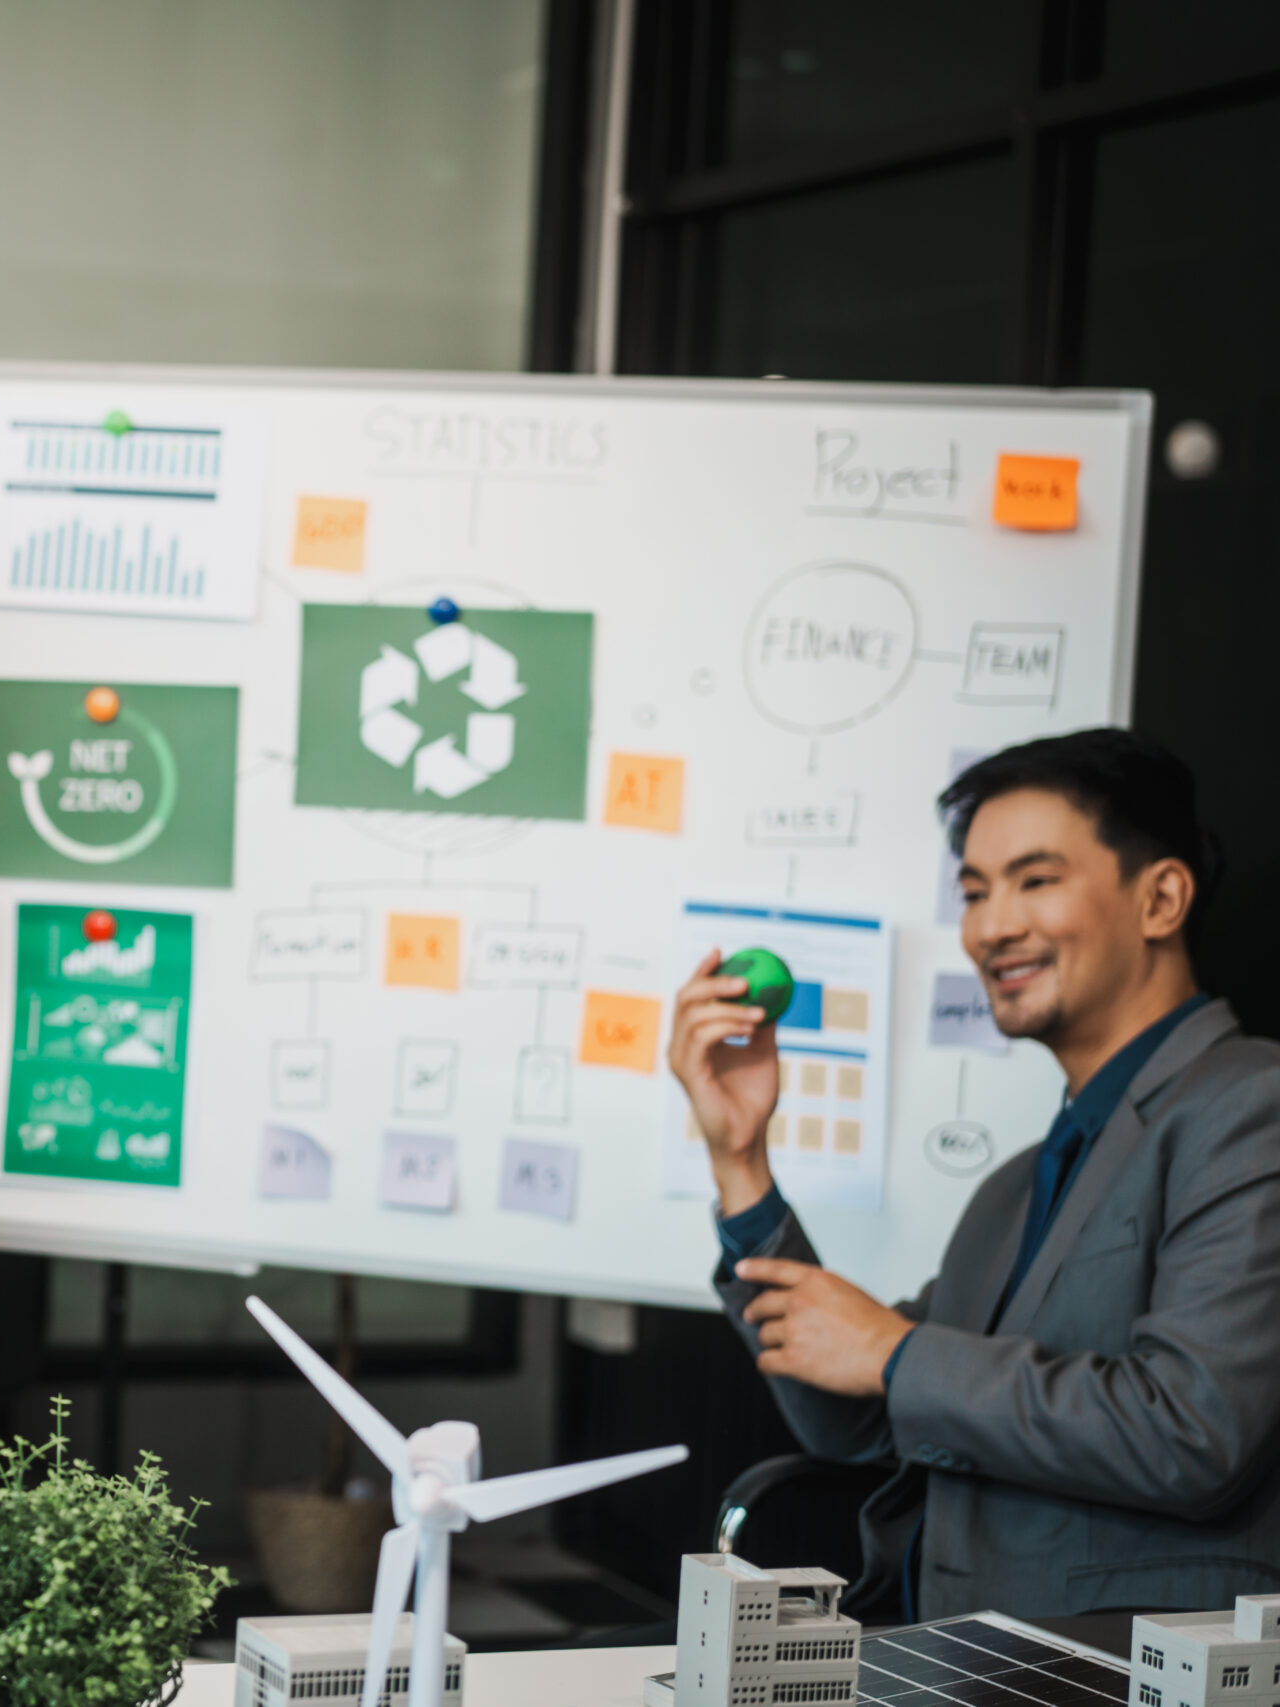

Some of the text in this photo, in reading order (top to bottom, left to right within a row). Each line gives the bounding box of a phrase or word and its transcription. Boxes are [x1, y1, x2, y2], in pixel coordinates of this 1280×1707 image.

[362, 405, 611, 468] STATISTICS
[814, 428, 963, 514] Project
[761, 615, 899, 670] FINANCE
[974, 639, 1053, 678] TEAM
[70, 739, 132, 773] NET
[59, 777, 144, 813] ZERO
